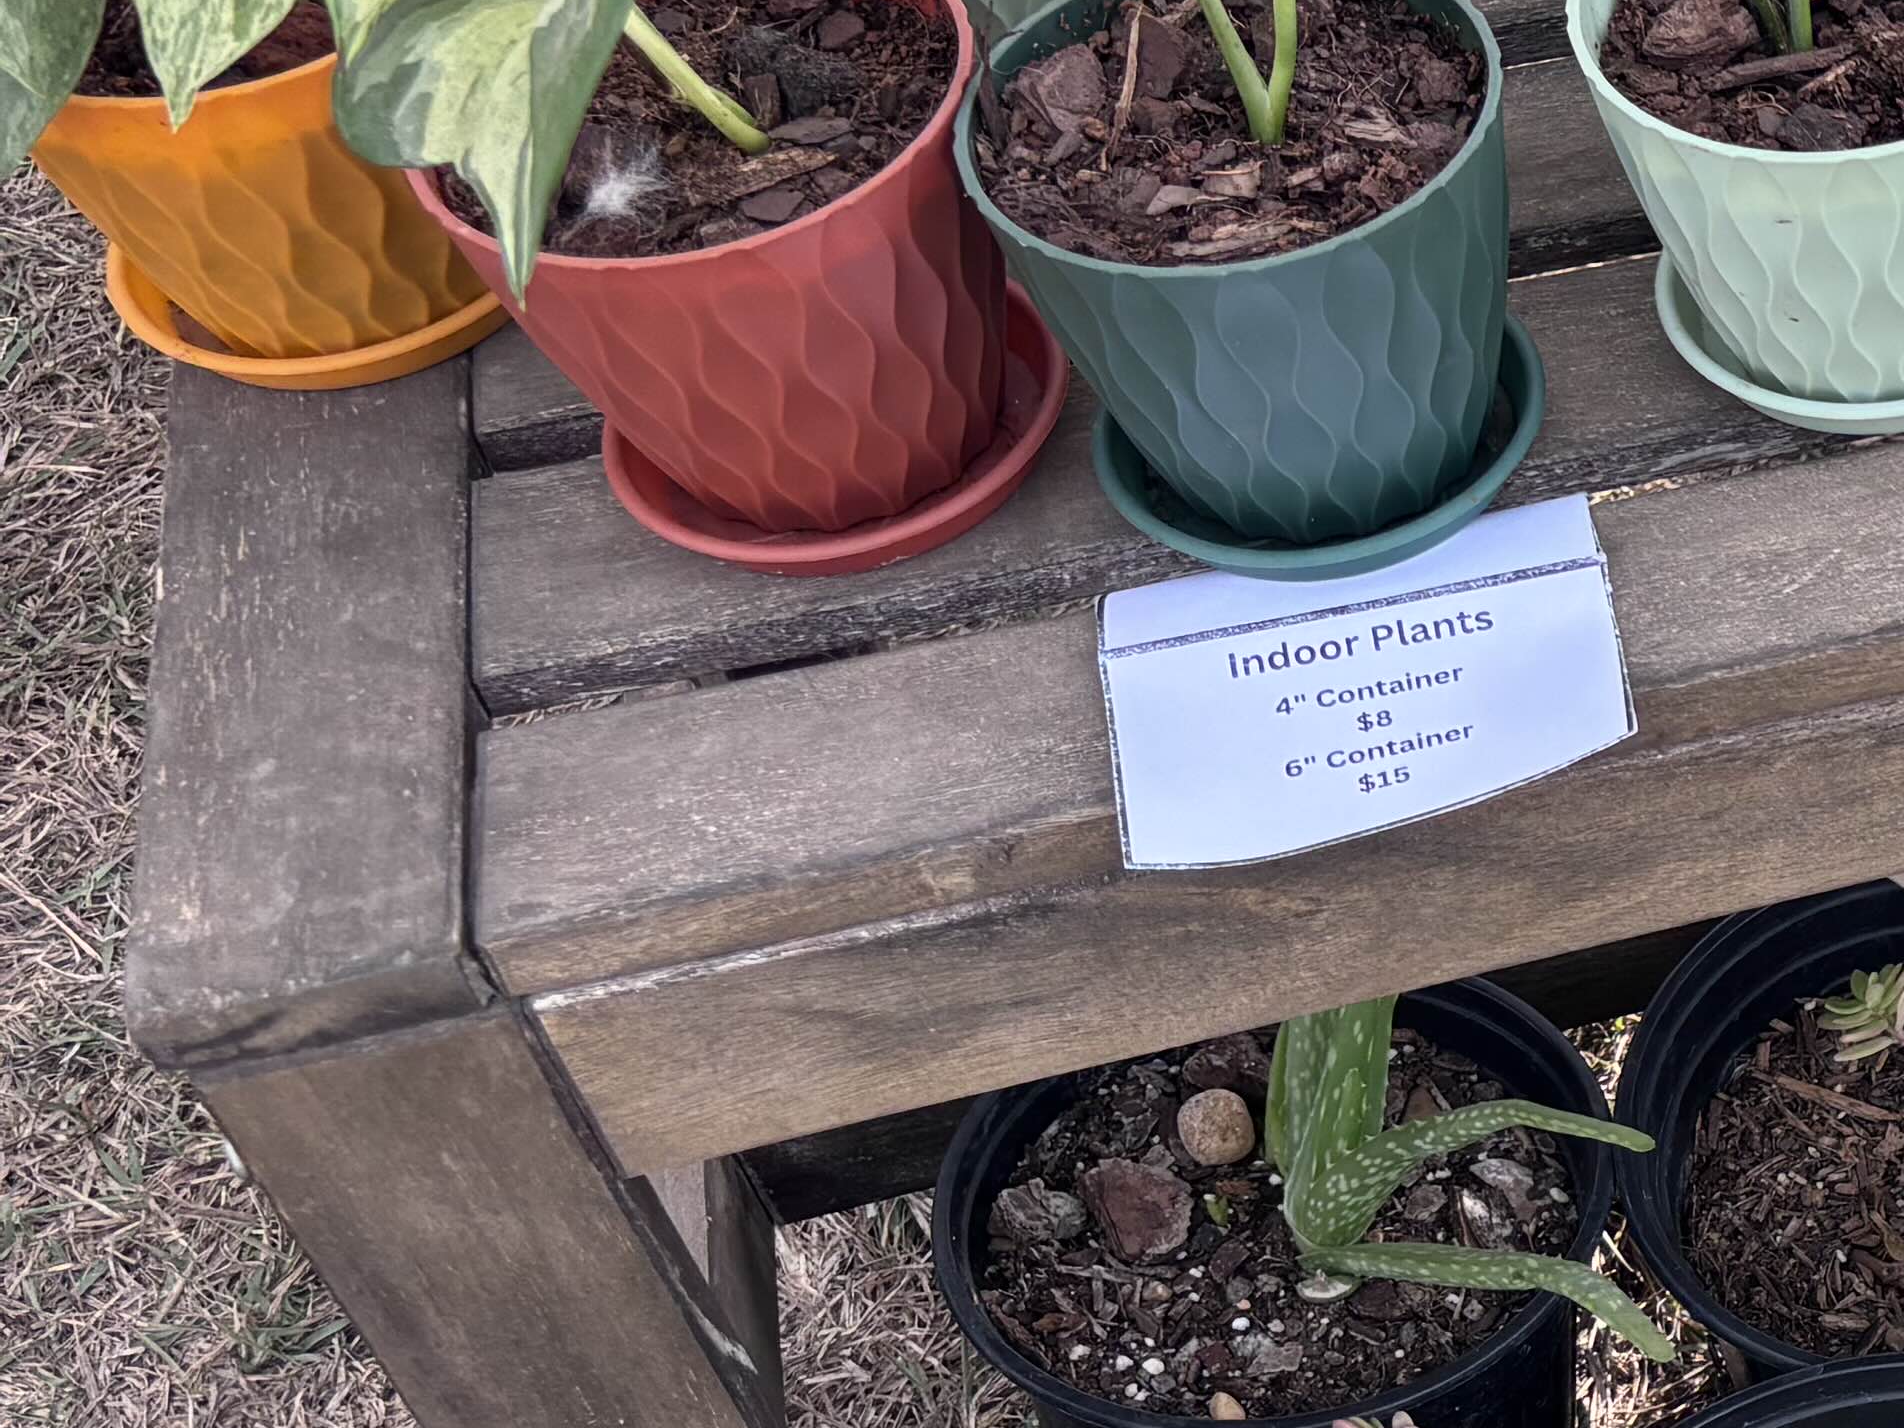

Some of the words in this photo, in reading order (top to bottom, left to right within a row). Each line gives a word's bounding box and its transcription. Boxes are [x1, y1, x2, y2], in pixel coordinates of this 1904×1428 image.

[1229, 636, 1359, 678] Indoor
[1371, 611, 1493, 651] Plants
[1276, 694, 1306, 715] 4"
[1316, 668, 1463, 707] Container
[1357, 710, 1392, 732] $8
[1286, 756, 1315, 777] 6"
[1327, 725, 1473, 768] Container
[1358, 766, 1410, 793] $15
